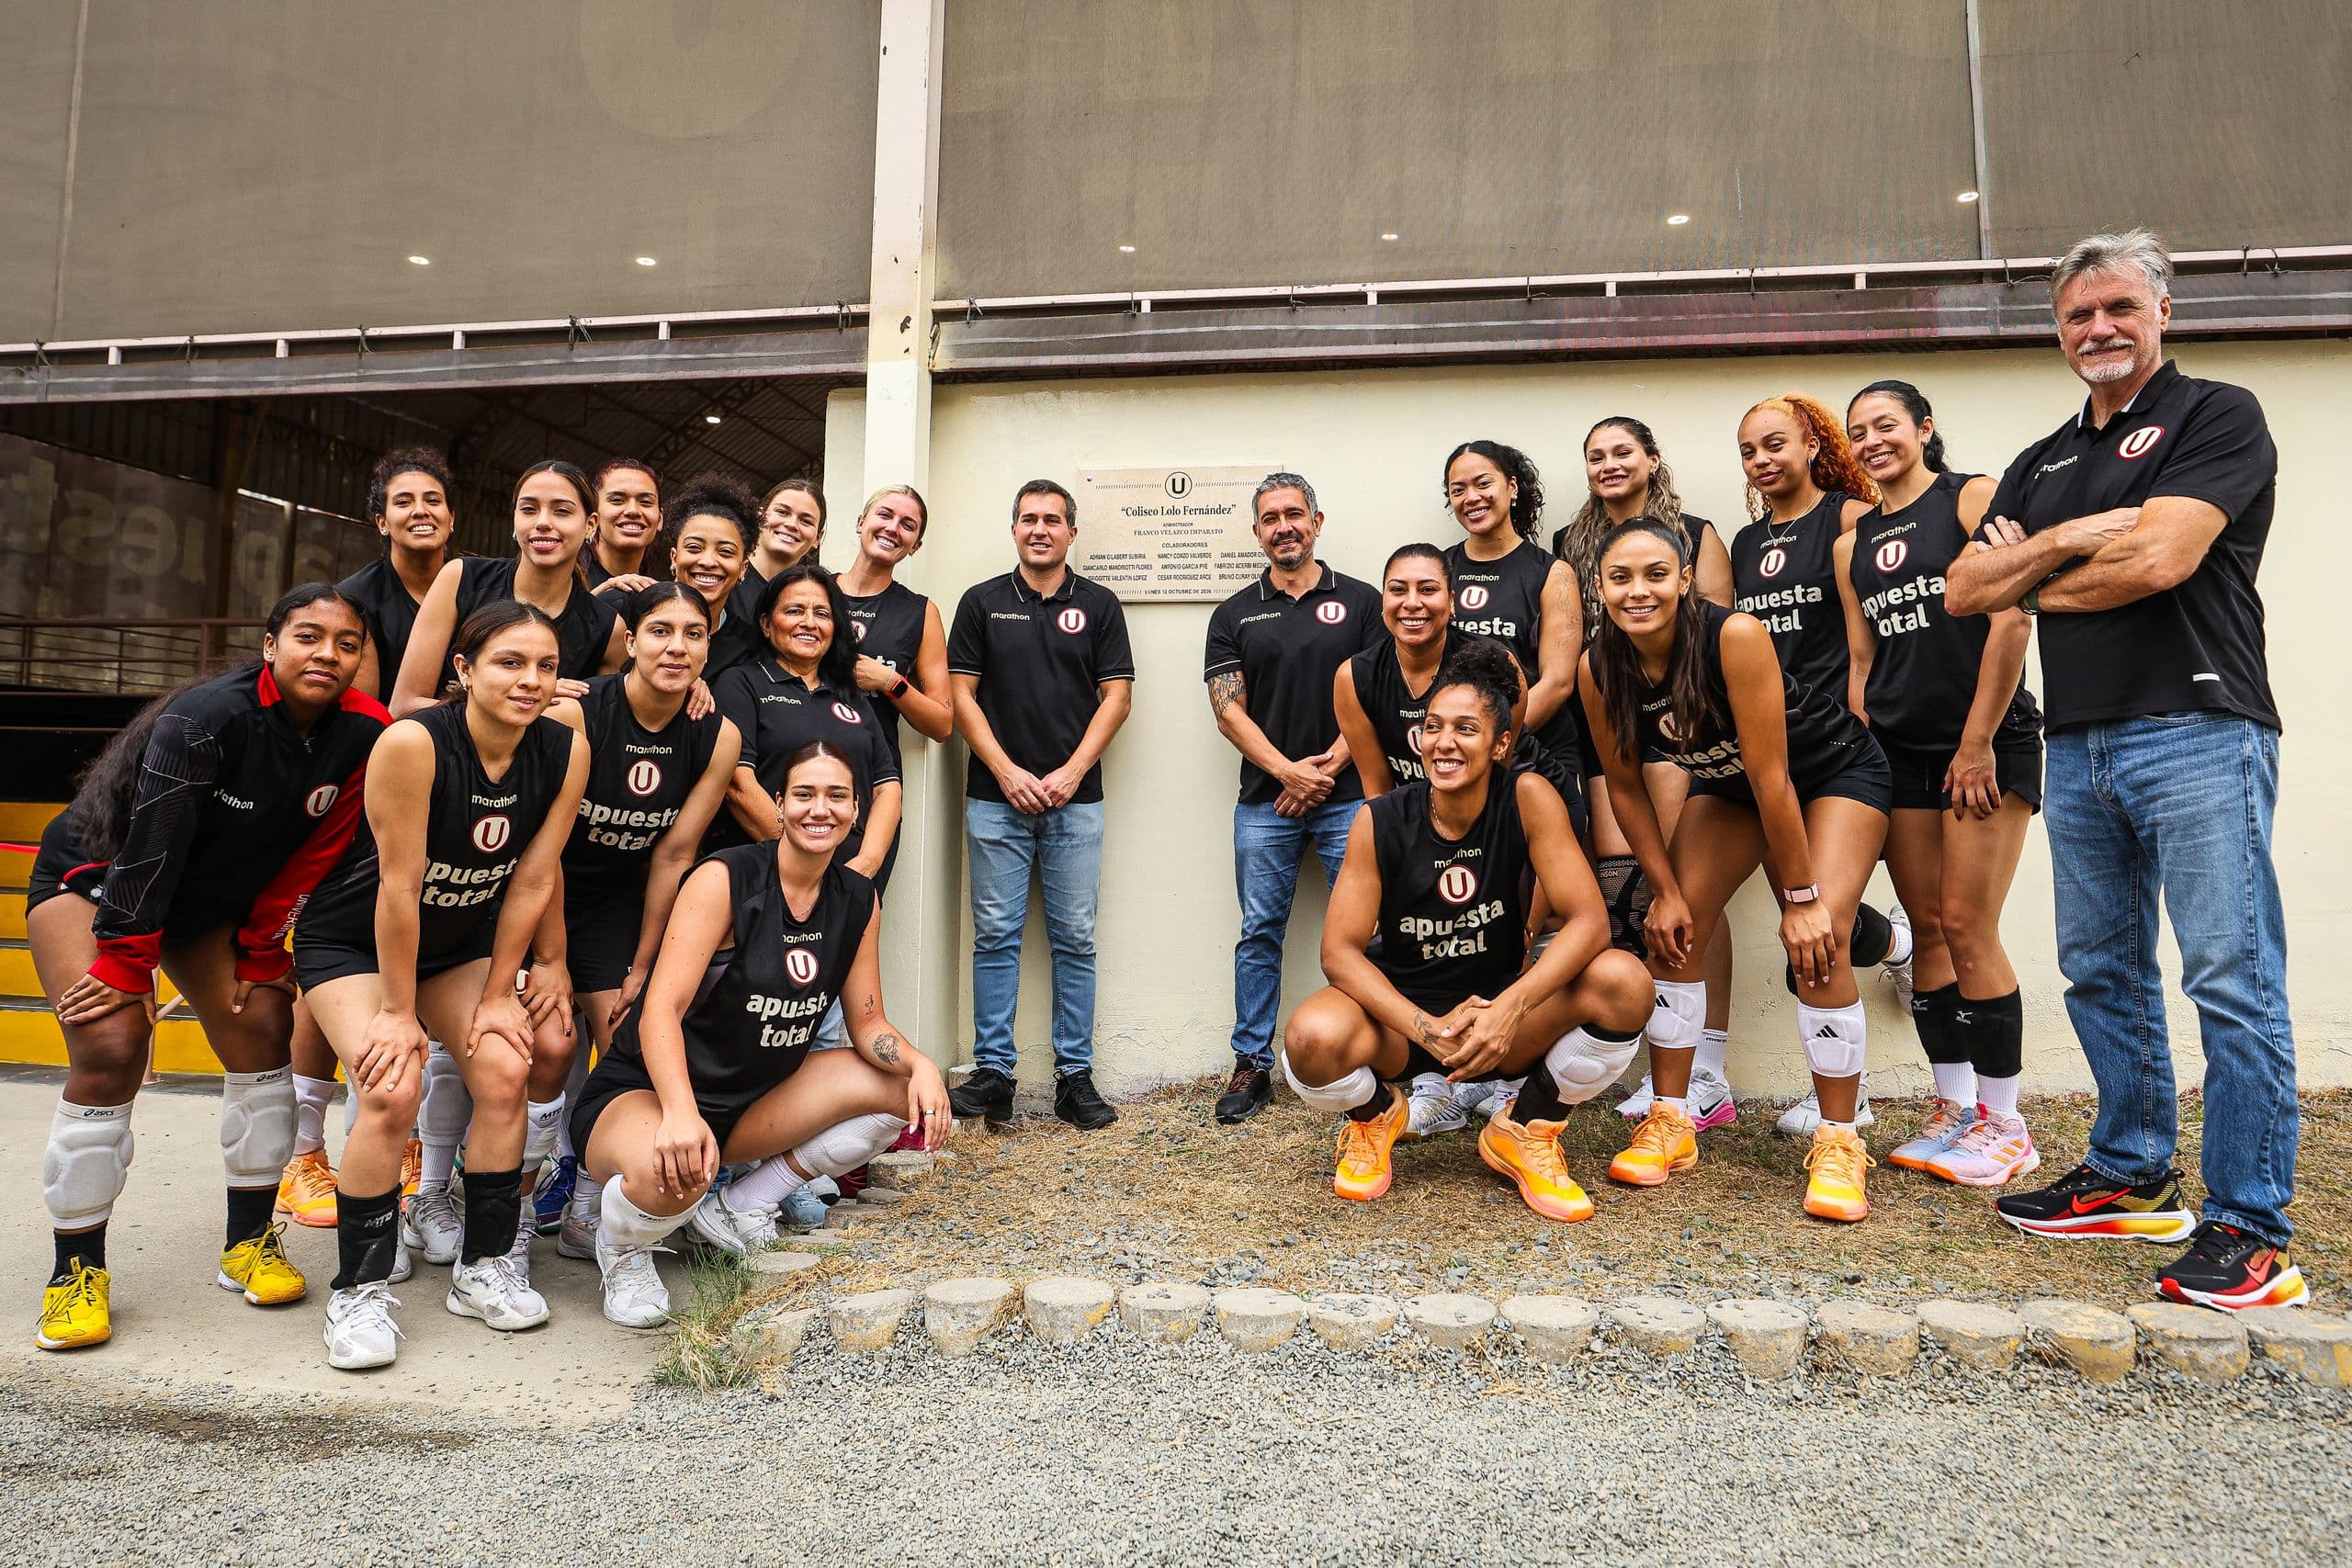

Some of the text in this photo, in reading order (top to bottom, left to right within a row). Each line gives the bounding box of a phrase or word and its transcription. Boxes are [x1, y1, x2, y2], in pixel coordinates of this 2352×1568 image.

[2035, 455, 2078, 479] rathon
[1171, 477, 1185, 494] U
[1121, 504, 1237, 516] “Coliseo Lolo Fernández”
[1871, 522, 1917, 544] marathon
[1458, 574, 1500, 582] marathon
[990, 612, 1030, 621] marathon
[1240, 611, 1282, 625] marathon
[1877, 603, 1930, 637] otal
[471, 793, 517, 808] marathon
[588, 826, 658, 851] total
[423, 880, 502, 908] total
[1421, 930, 1487, 960] total
